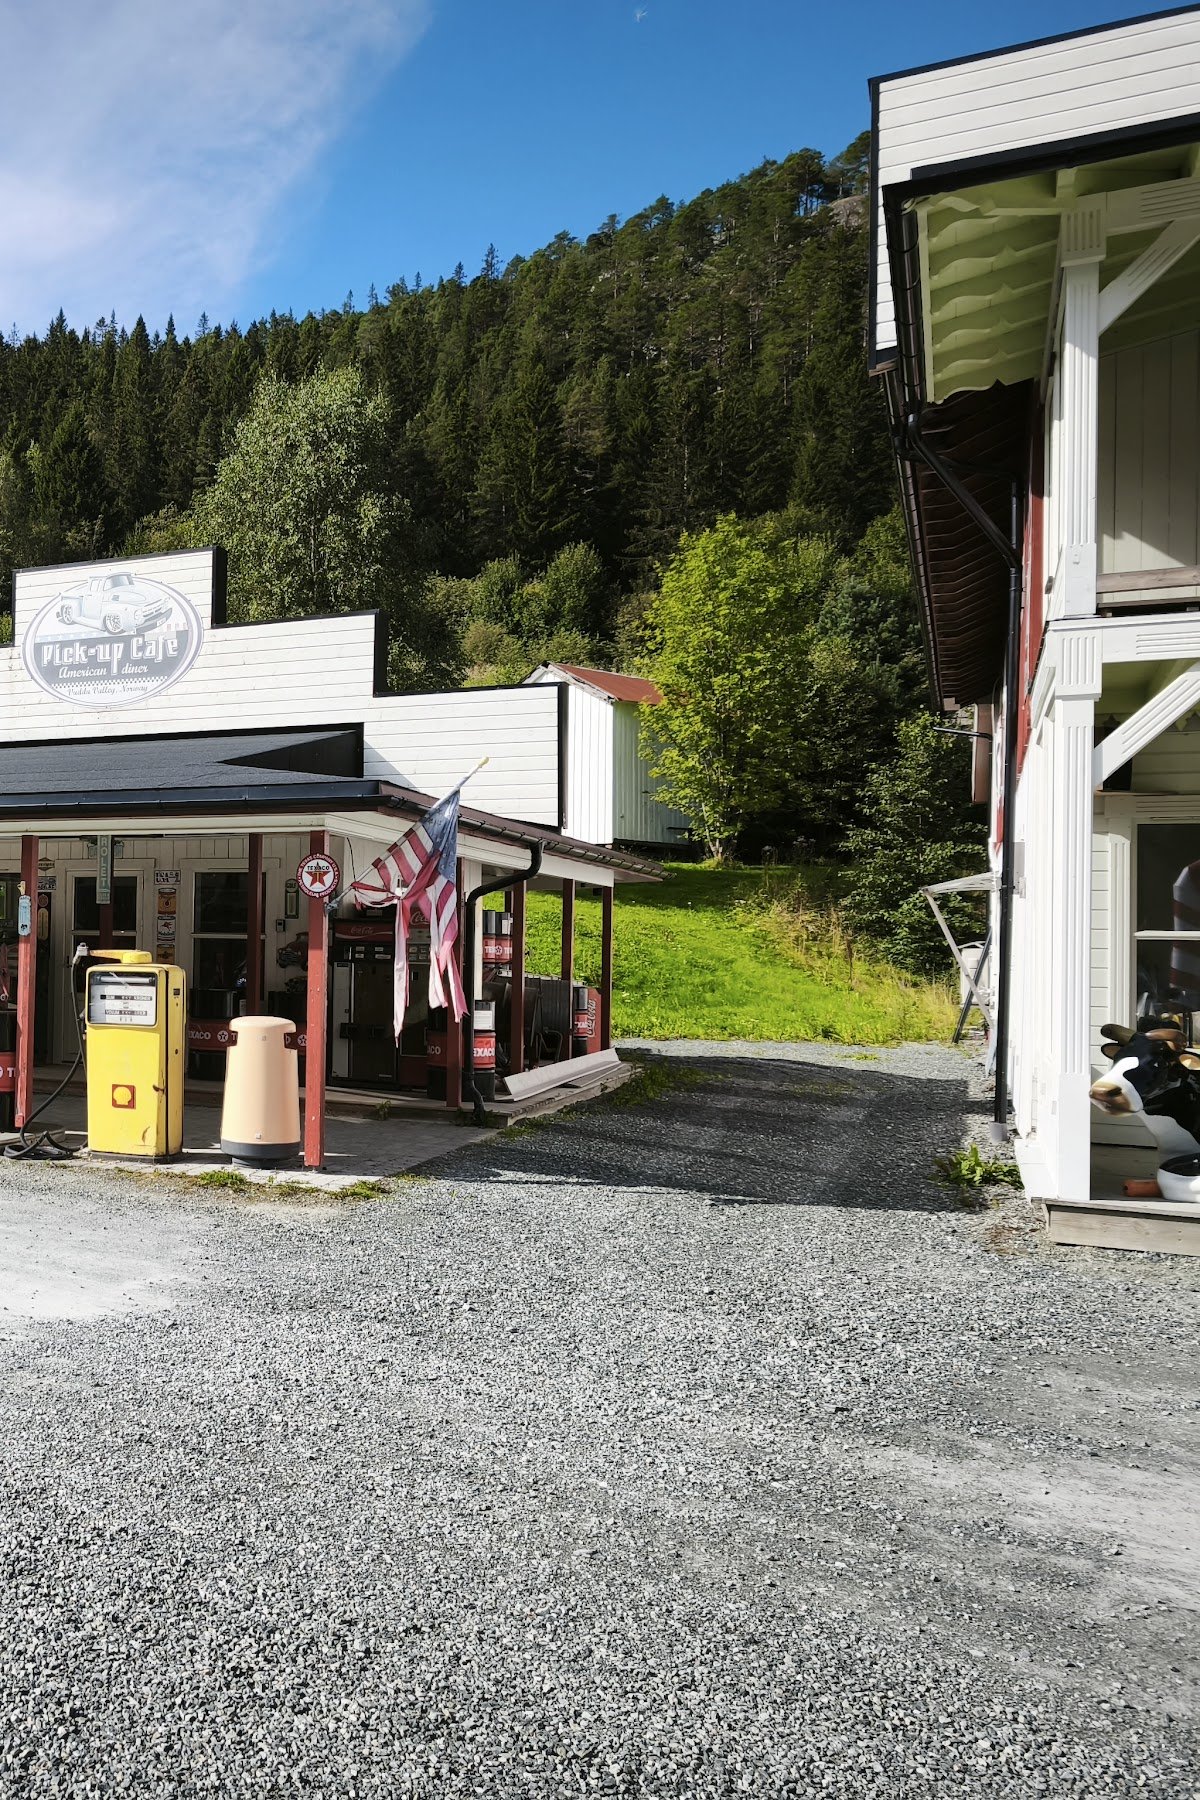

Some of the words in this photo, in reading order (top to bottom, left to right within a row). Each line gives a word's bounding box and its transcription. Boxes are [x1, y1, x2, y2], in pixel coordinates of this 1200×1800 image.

[41, 641, 124, 676] Pick-up
[59, 666, 107, 679] American
[121, 662, 149, 675] diner
[120, 683, 149, 693] Norway
[100, 836, 109, 887] ROLET
